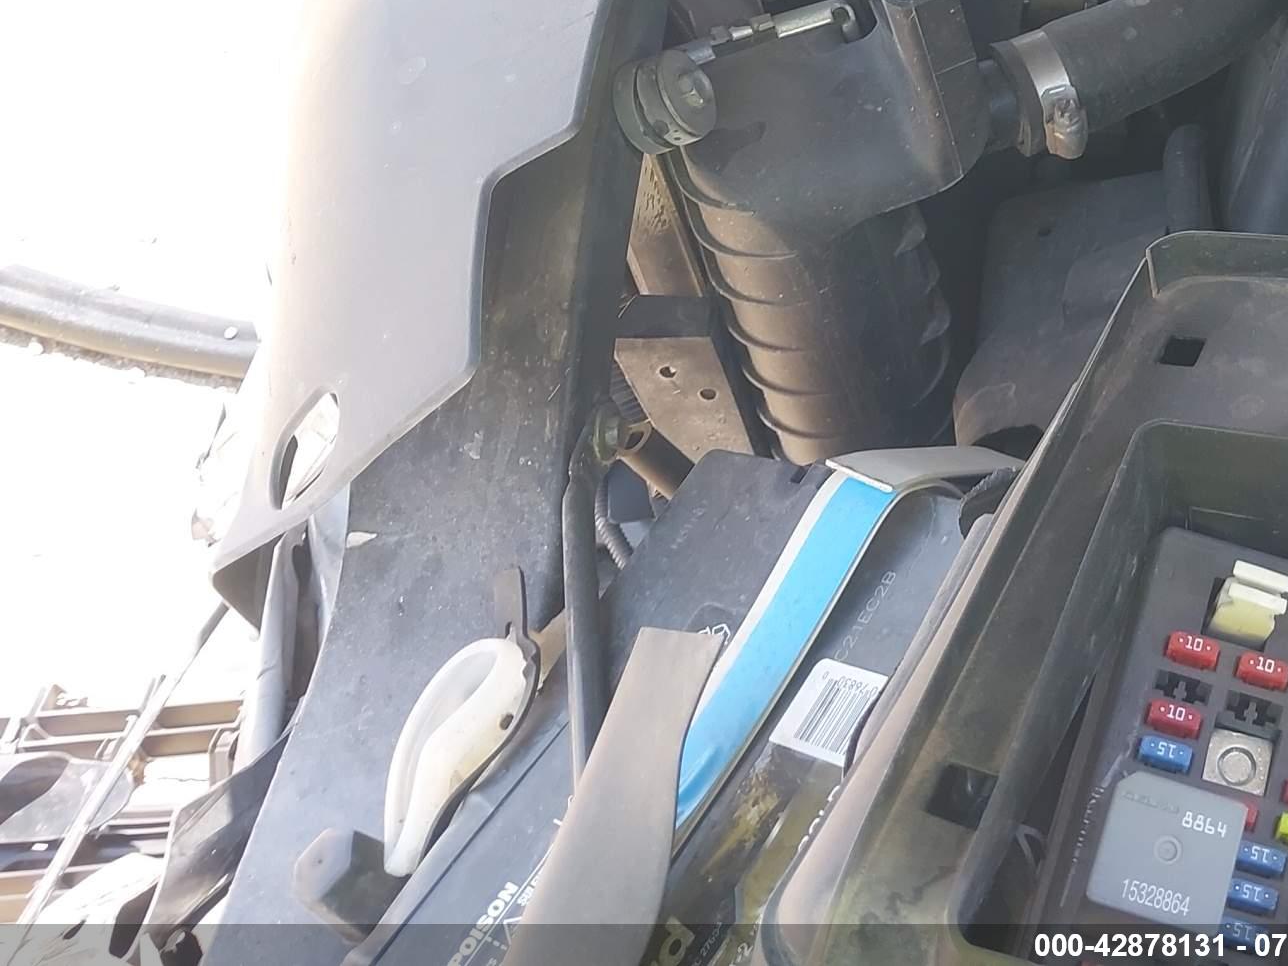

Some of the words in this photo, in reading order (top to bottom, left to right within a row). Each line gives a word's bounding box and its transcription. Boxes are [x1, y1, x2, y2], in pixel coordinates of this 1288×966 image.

[1185, 636, 1203, 651] 10
[1256, 656, 1275, 673] 10
[1167, 705, 1185, 721] 10
[1157, 741, 1176, 759] 15
[1182, 811, 1228, 838] 8864
[1250, 845, 1270, 863] 15
[1122, 879, 1190, 916] 15328864
[1242, 884, 1261, 902] 15
[1233, 923, 1252, 940] 15
